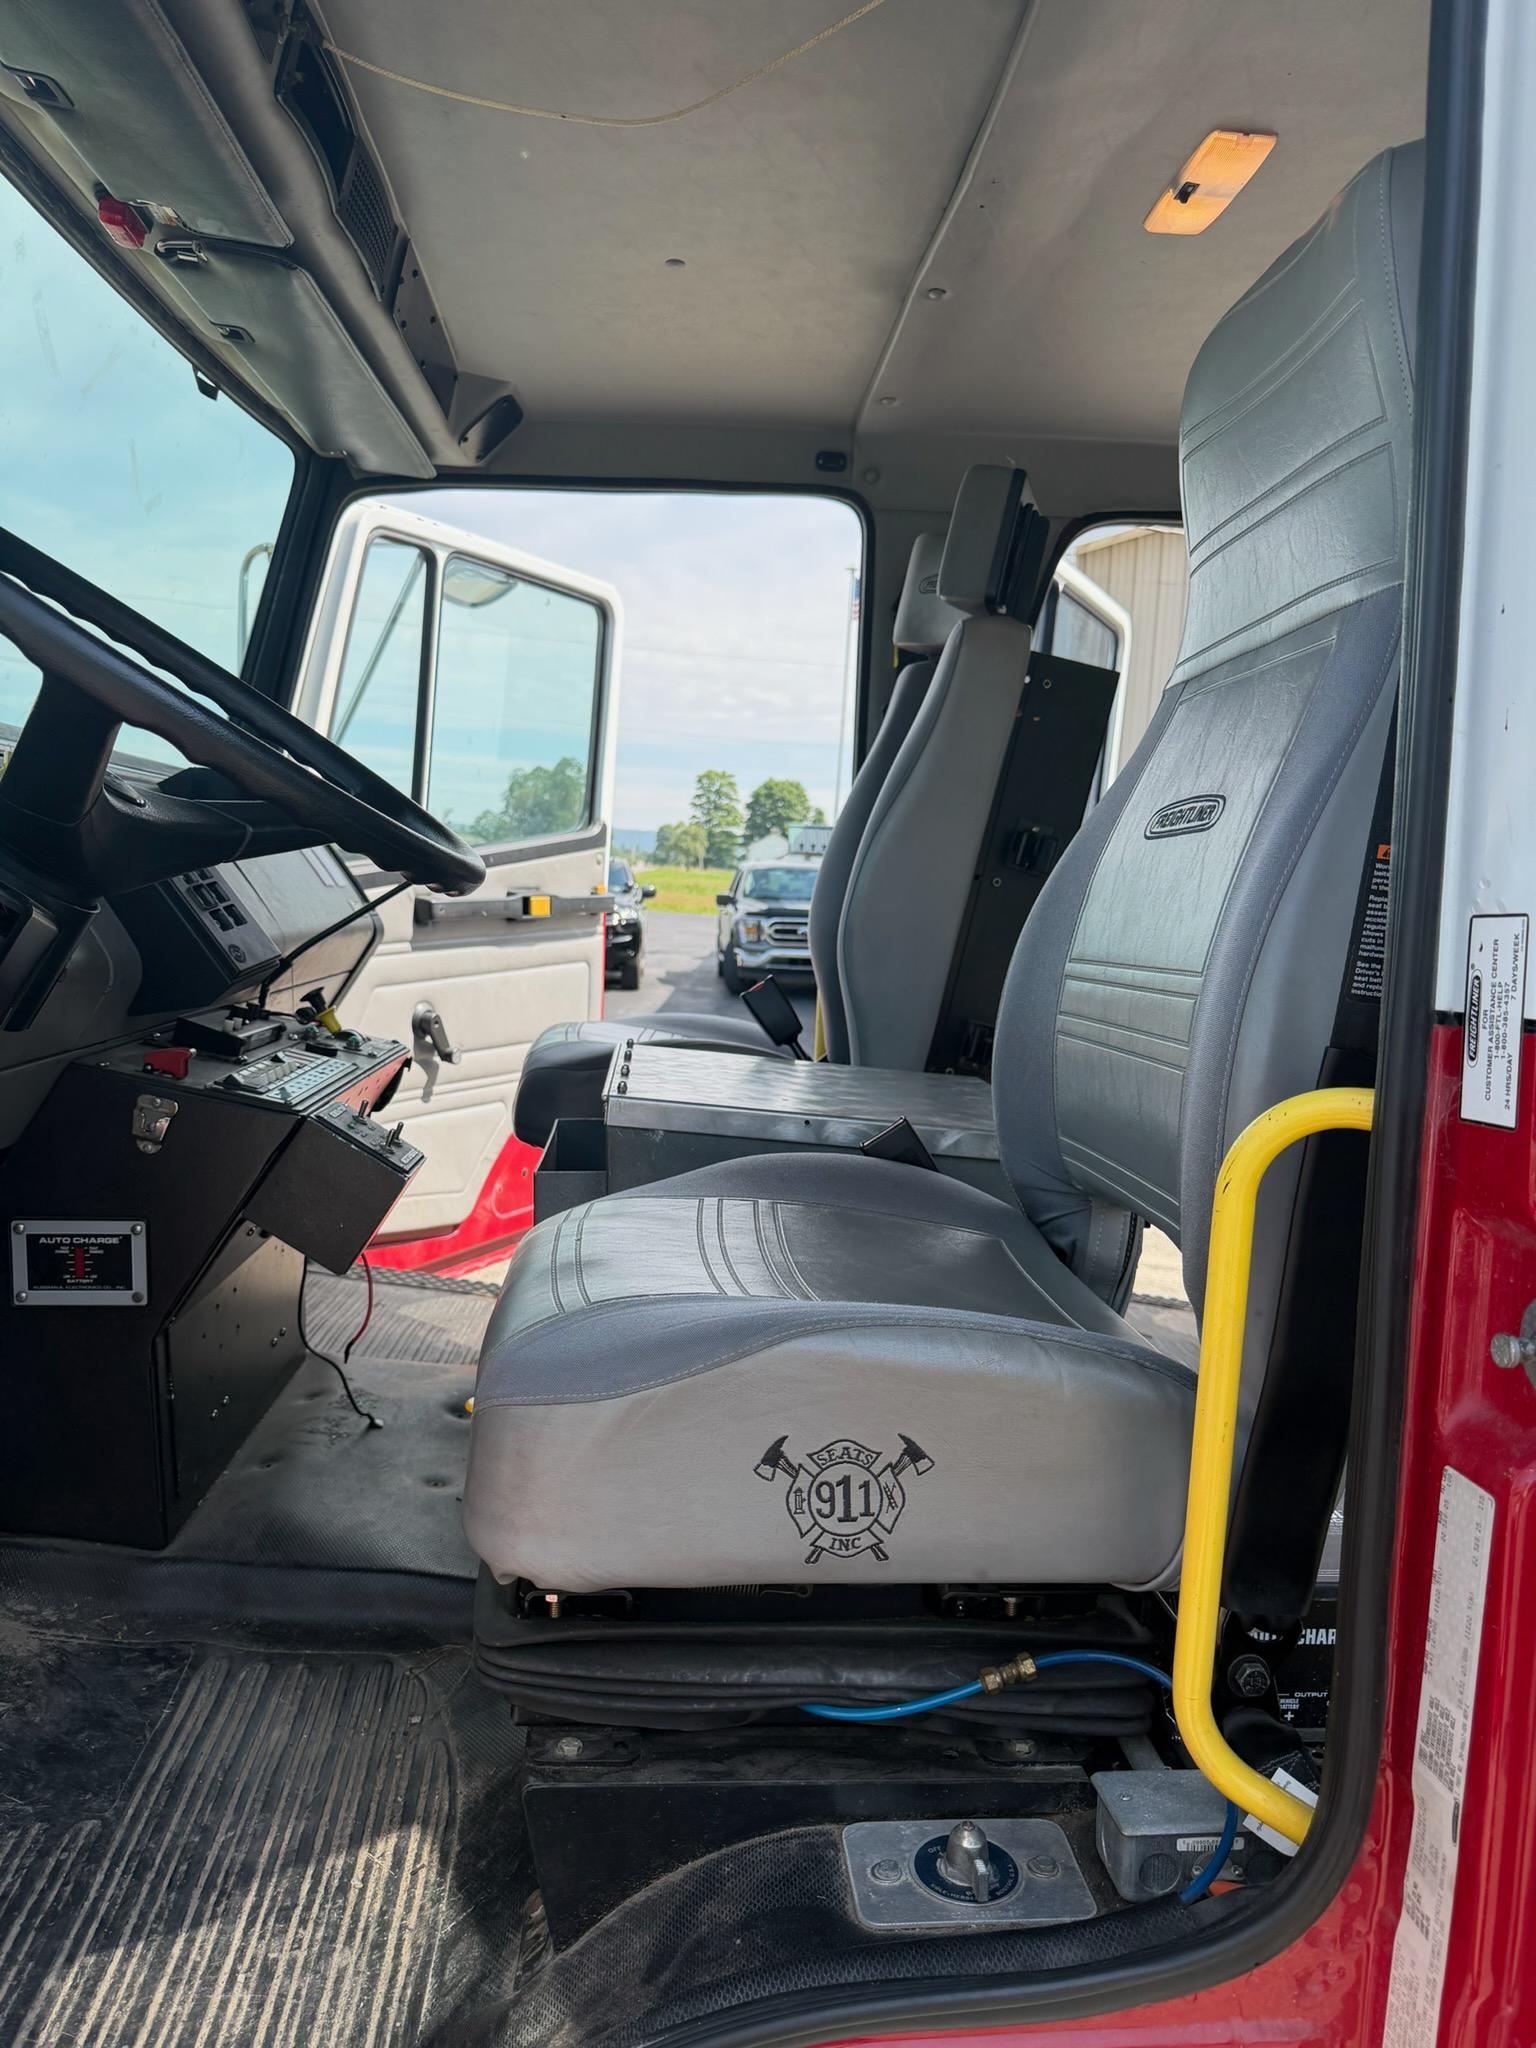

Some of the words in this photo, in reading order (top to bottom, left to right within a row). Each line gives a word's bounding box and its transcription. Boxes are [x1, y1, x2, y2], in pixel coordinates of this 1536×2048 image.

[1152, 803, 1217, 829] FREIGHTLINER
[1491, 939, 1500, 979] CENTER
[1511, 932, 1520, 992] DAYS/WEEK
[1468, 976, 1481, 1059] FREIGHTLINER
[1481, 1009, 1489, 1030] FOR
[1488, 981, 1498, 1044] ASSISTANCE
[1494, 981, 1504, 1059] 1-800-FTL-HELP
[1484, 1046, 1494, 1101] CUSTOMER
[1504, 1052, 1513, 1097] HRS/DAY
[1504, 1099, 1511, 1110] 24
[39, 1236, 71, 1244] AUTO
[72, 1236, 120, 1245] CHARGE
[816, 1446, 874, 1467] SEATS
[815, 1474, 875, 1523] 911
[828, 1537, 863, 1551] INC
